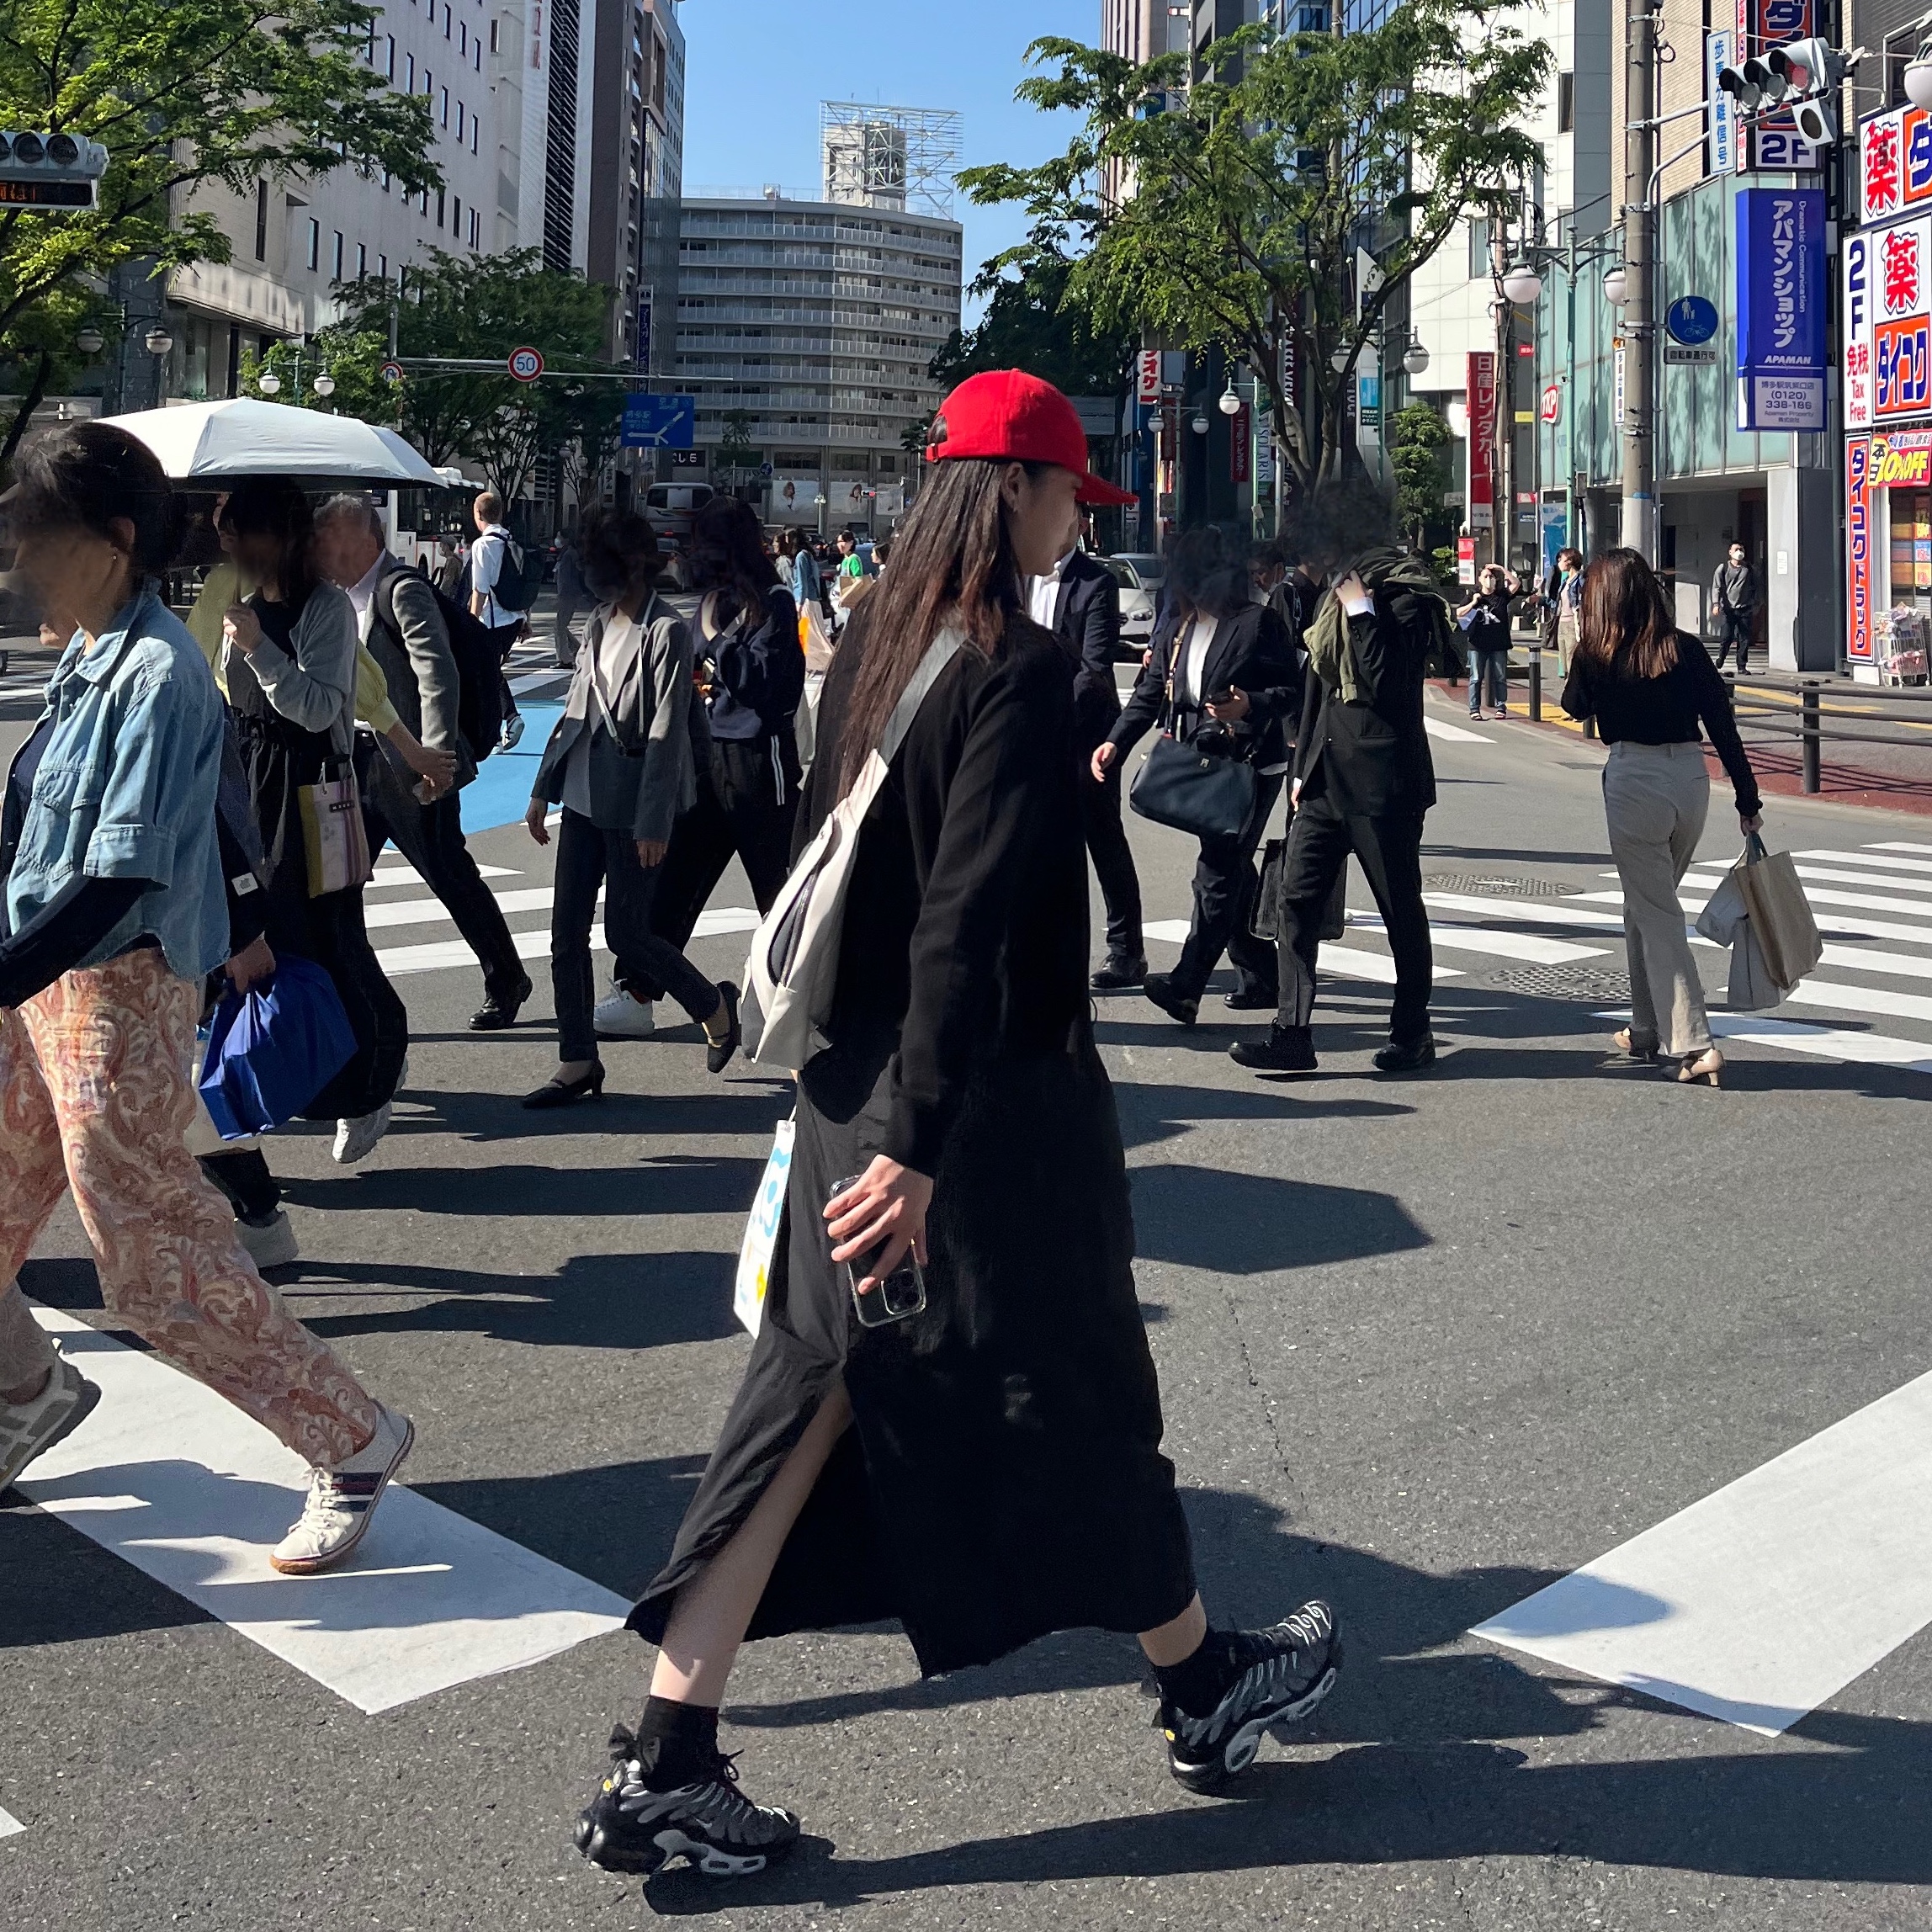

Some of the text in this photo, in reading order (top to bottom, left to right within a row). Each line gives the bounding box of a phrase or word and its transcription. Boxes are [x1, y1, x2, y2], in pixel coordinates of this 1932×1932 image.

[1761, 133, 1811, 165] 2F
[1864, 121, 1899, 216] 薬
[1798, 200, 1807, 313] Dramatic Communication
[1882, 231, 1919, 313] 薬
[1772, 199, 1796, 348] アパマンショップ
[517, 357, 536, 371] 50
[1765, 355, 1812, 364] APAMAN
[1847, 342, 1869, 377] 免税
[1877, 330, 1928, 406] ダイコク
[1542, 389, 1557, 416] TKP
[1765, 401, 1813, 410] 338-186
[1771, 390, 1807, 401] (0120)
[1851, 380, 1865, 400] Tax
[1477, 355, 1494, 465] 日産レンタカー
[1850, 401, 1866, 422] Free
[1852, 448, 1866, 650] ダイコクドラッグ
